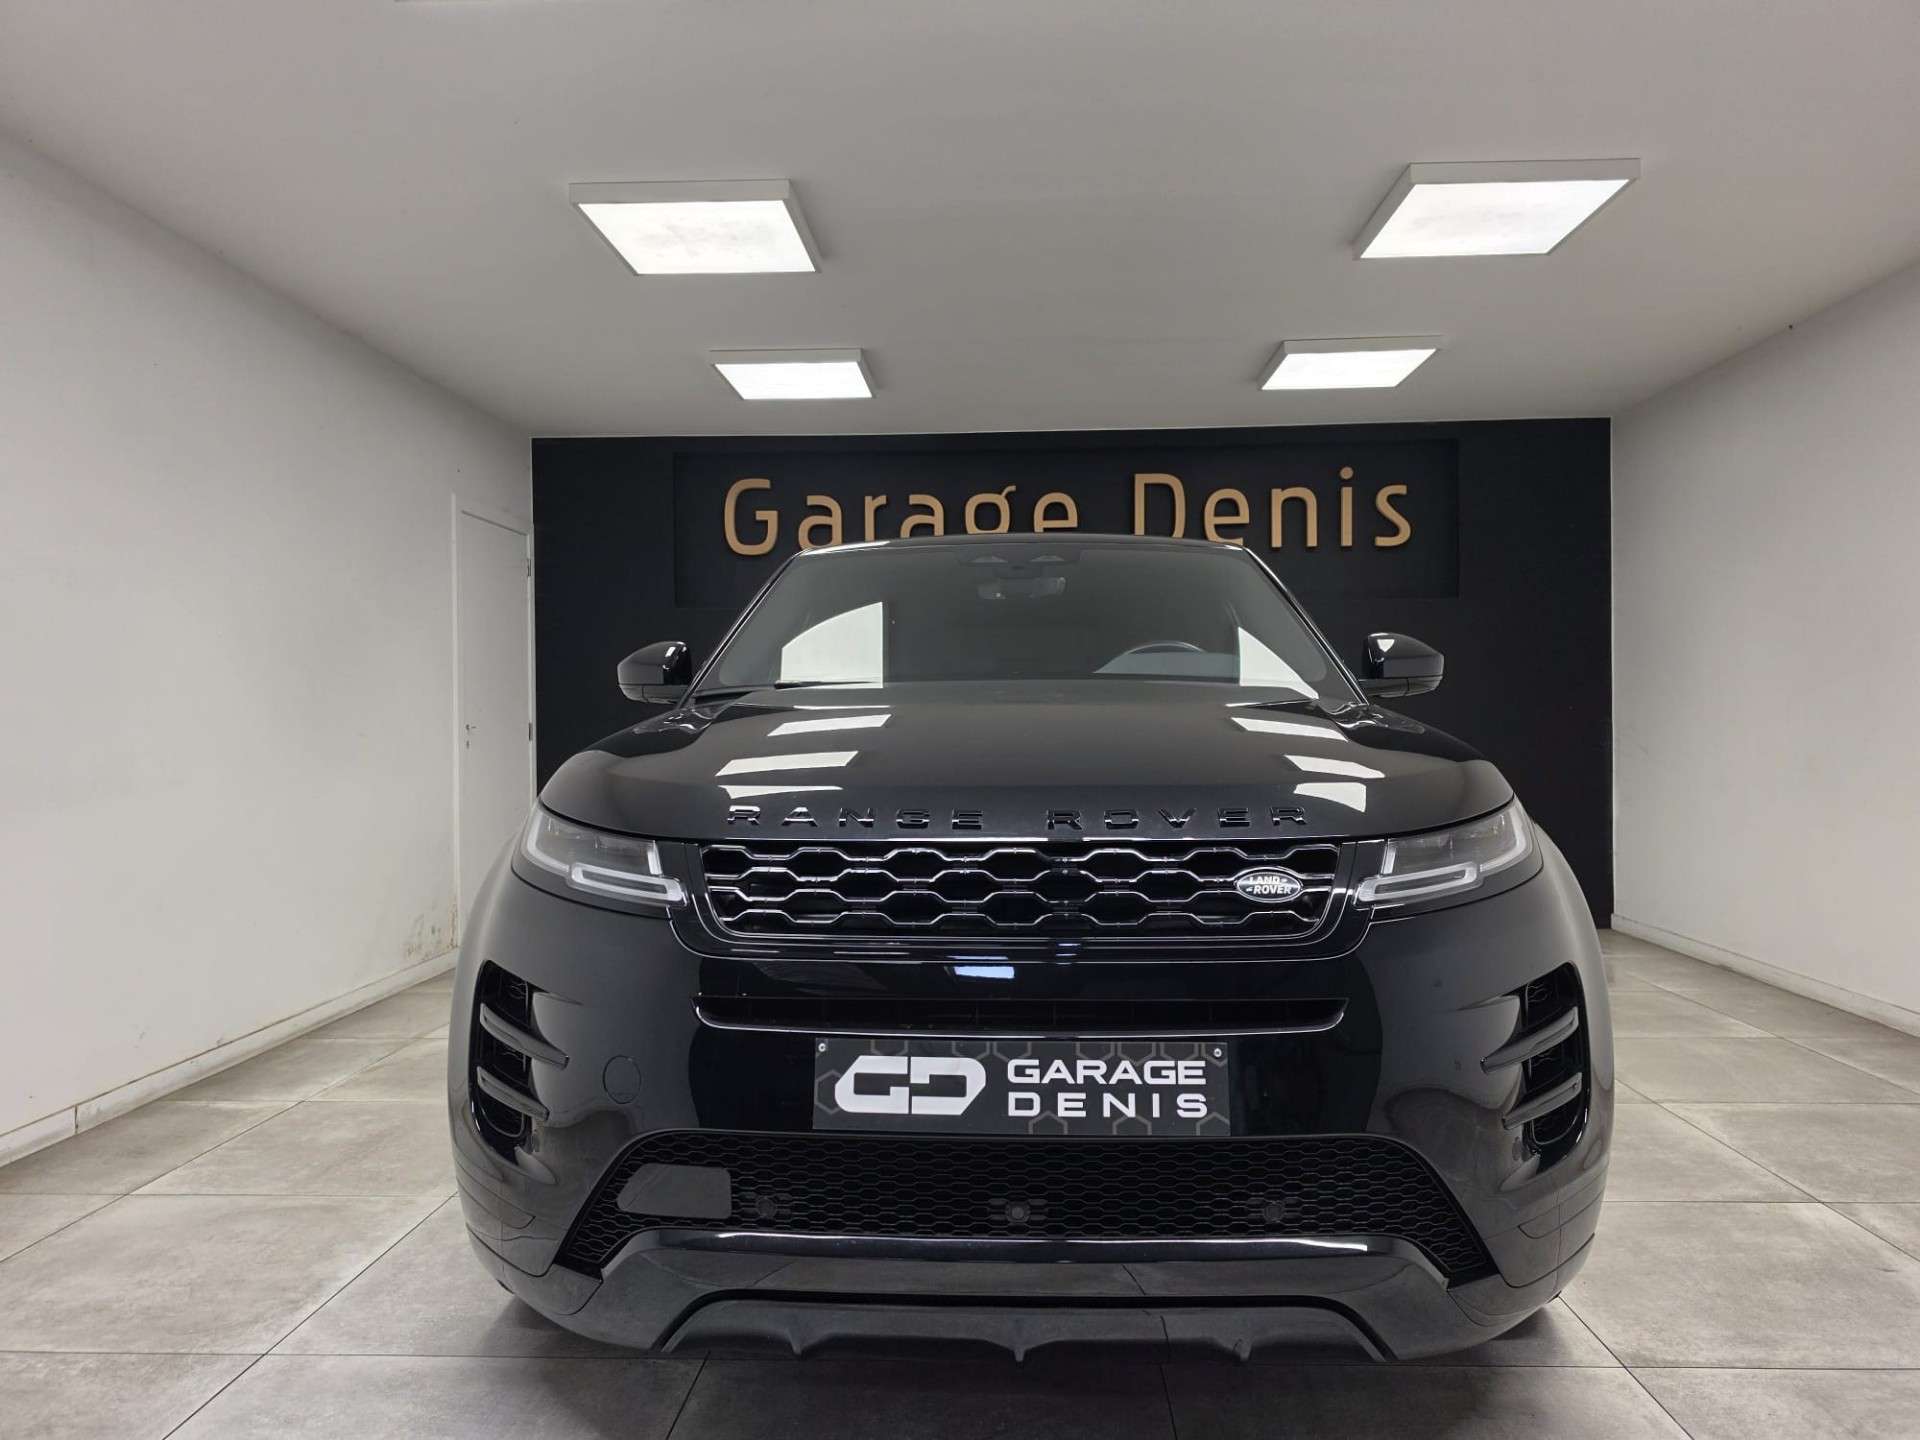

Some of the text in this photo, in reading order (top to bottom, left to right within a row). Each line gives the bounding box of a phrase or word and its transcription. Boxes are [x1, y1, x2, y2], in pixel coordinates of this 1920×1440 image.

[724, 466, 1412, 556] Garage Denis
[727, 805, 1307, 830] RANGE ROVER
[1249, 876, 1280, 884] LAND
[1253, 885, 1292, 894] ROVER
[1007, 1058, 1207, 1085] GARAGE
[1007, 1091, 1208, 1118] DENIS
